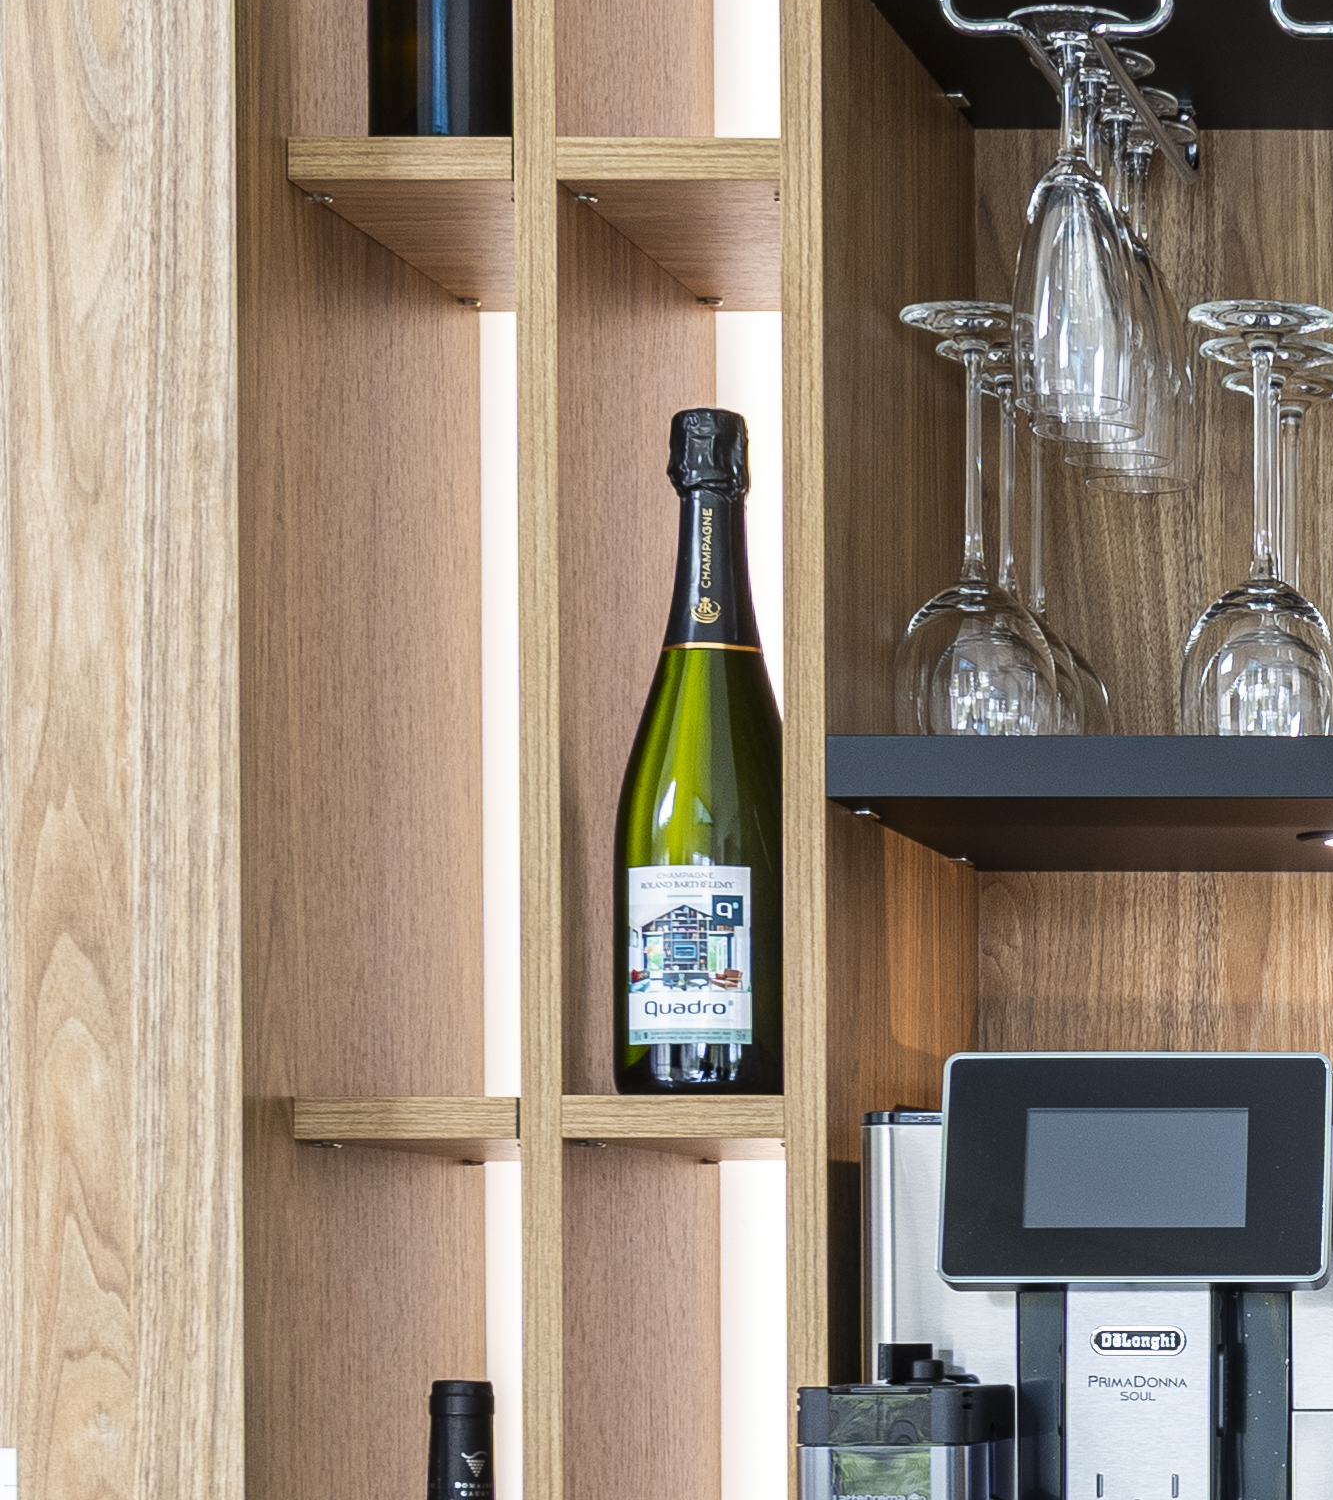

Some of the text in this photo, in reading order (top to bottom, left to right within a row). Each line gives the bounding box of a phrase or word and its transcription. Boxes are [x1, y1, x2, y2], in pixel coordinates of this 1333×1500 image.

[701, 507, 713, 589] CHAMPAGNE
[656, 871, 716, 880] CHAMPAGNE
[641, 881, 673, 890] ROLAND
[645, 1000, 728, 1018] Quadro
[1120, 1391, 1157, 1402] SOUL
